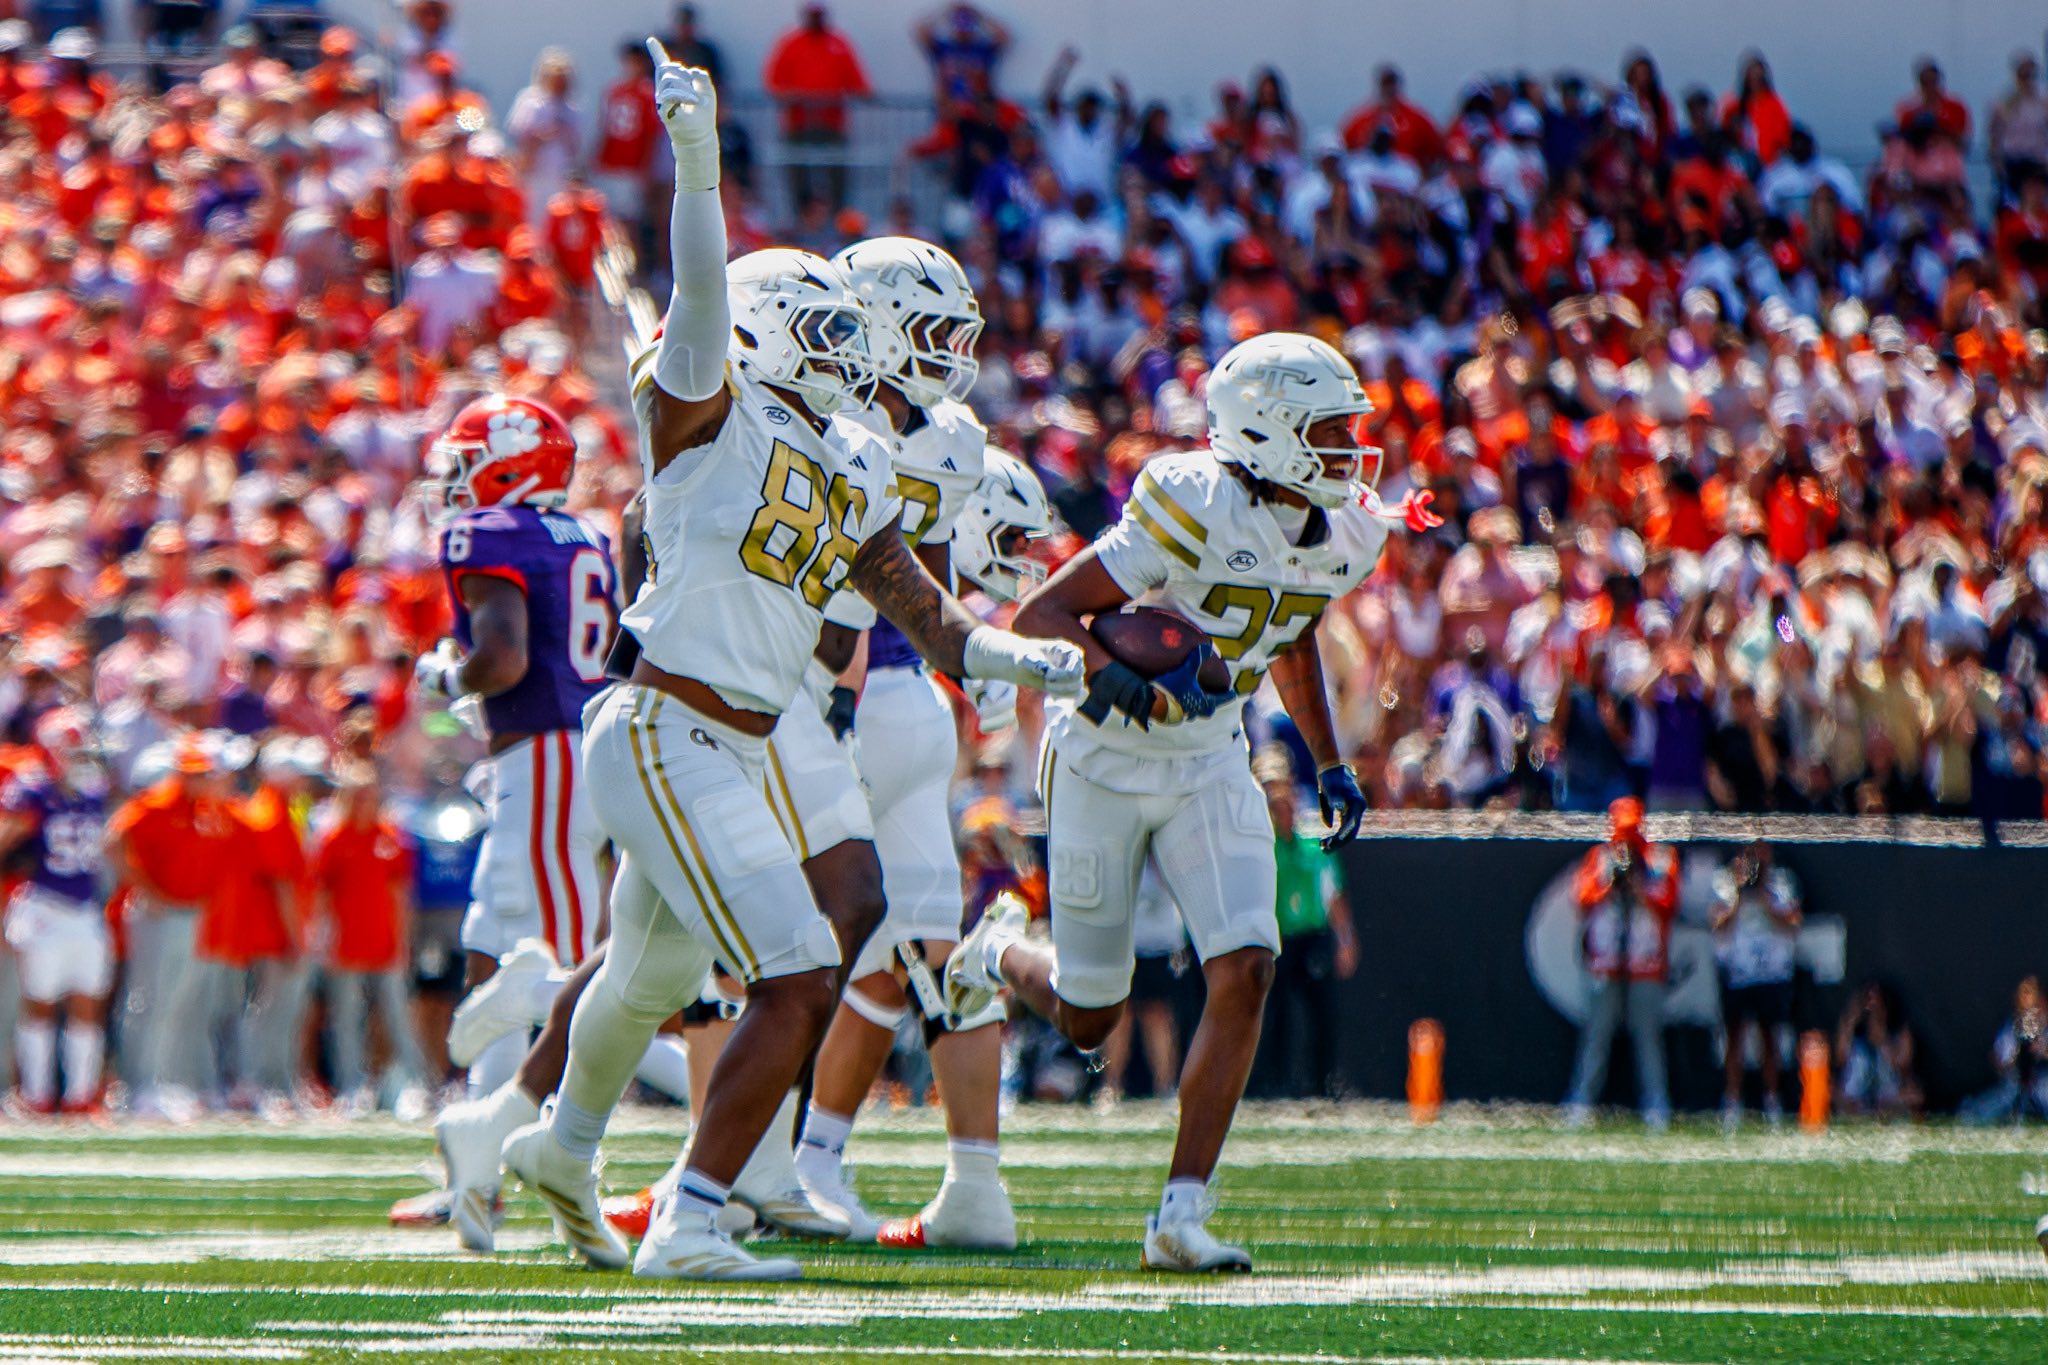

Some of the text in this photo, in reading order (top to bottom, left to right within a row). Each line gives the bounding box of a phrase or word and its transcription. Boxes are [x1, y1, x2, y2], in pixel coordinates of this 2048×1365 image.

[448, 526, 472, 562] 6
[739, 437, 869, 613] 88
[568, 549, 611, 683] 6
